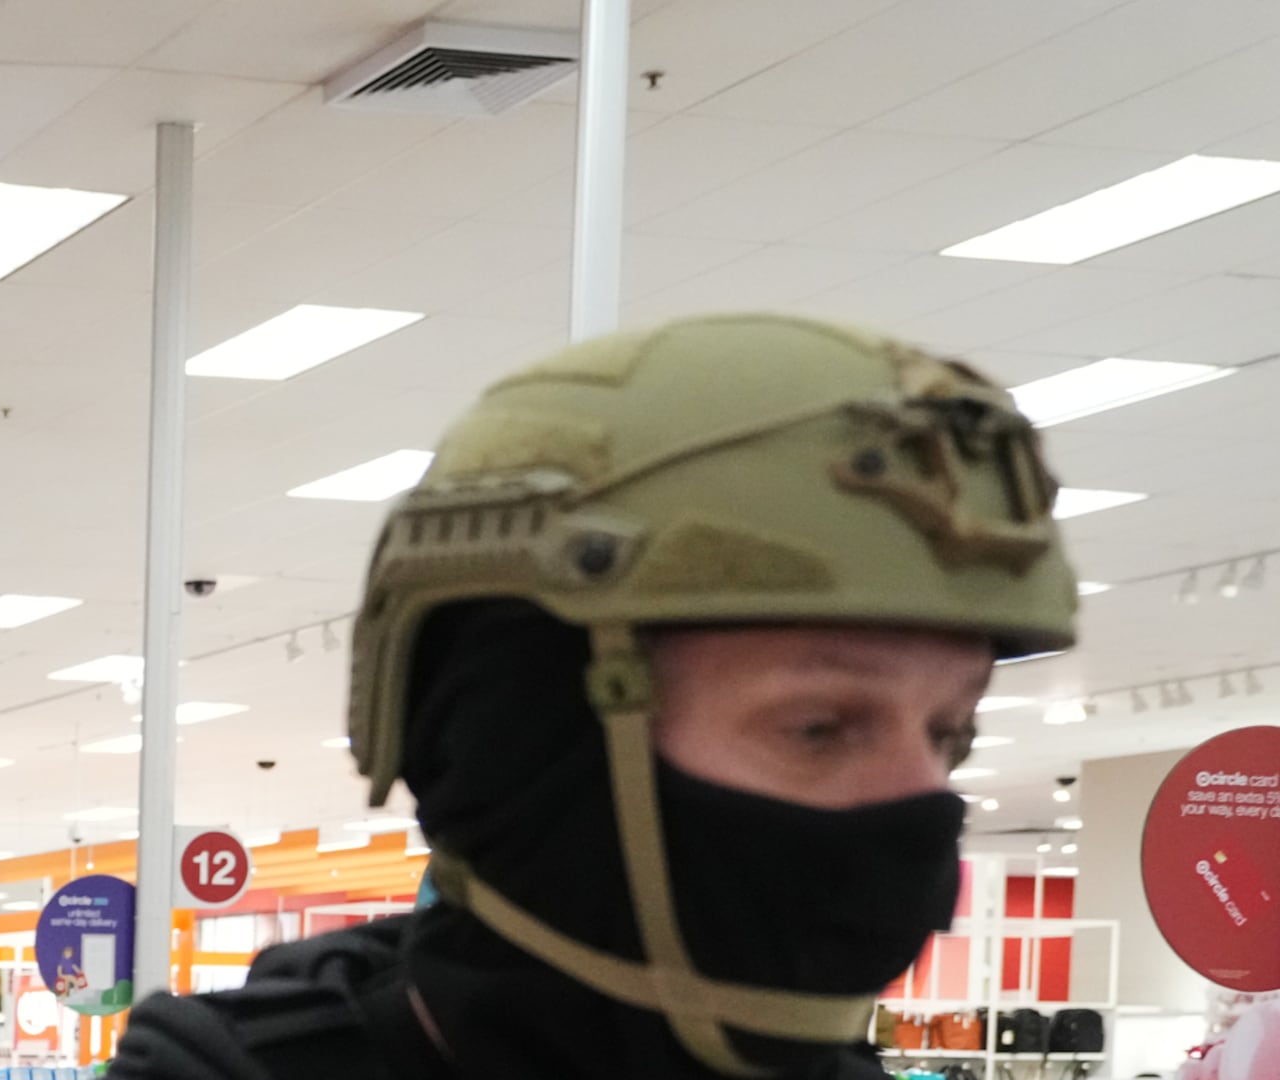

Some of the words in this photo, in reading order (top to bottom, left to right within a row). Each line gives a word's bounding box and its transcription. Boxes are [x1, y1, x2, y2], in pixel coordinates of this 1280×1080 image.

[1249, 773, 1279, 788] card
[1187, 790, 1216, 803] save
[1217, 792, 1234, 803] an
[1235, 792, 1265, 804] extra
[1180, 803, 1206, 817] your
[1235, 806, 1269, 820] every
[192, 851, 237, 885] 12
